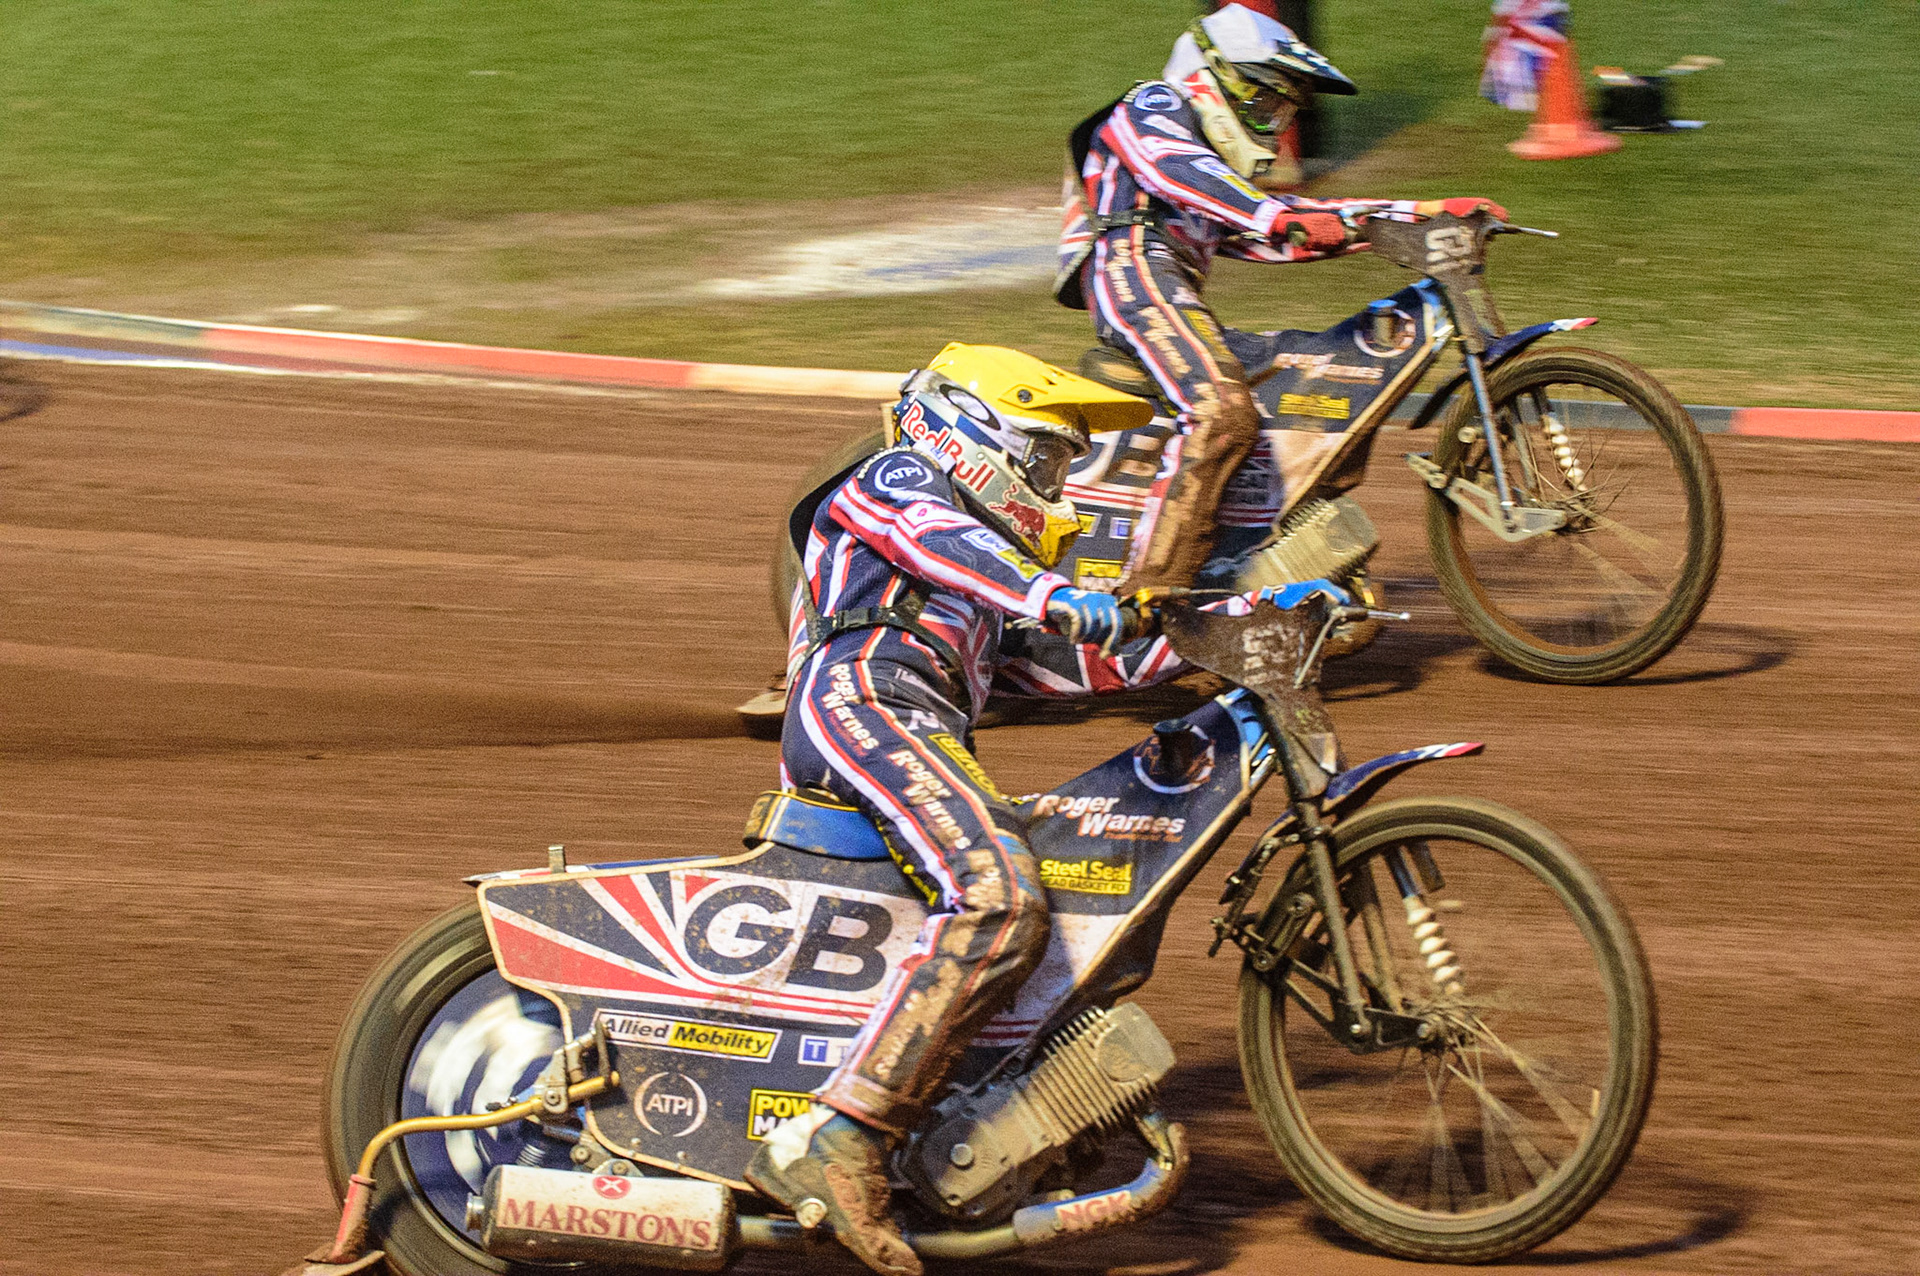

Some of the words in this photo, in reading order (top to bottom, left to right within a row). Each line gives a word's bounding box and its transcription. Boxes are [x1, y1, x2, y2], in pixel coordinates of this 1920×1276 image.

[901, 401, 951, 450] Red
[944, 439, 998, 494] Bull
[884, 466, 924, 486] ATPI
[828, 663, 866, 704] Roger
[821, 691, 879, 750] Warnes
[887, 750, 951, 798] Roger
[903, 783, 972, 851] Warnes
[1033, 794, 1120, 819] Roger
[1077, 812, 1186, 837] Warnes
[1040, 859, 1088, 878] Steel
[1090, 861, 1132, 881] Seal
[684, 884, 893, 992] GB
[604, 1017, 670, 1039] Allied
[674, 1026, 769, 1054] Mobility
[645, 1093, 693, 1117] ATPI
[502, 1197, 712, 1248] MARSTON'S
[1057, 1191, 1128, 1229] NGK
